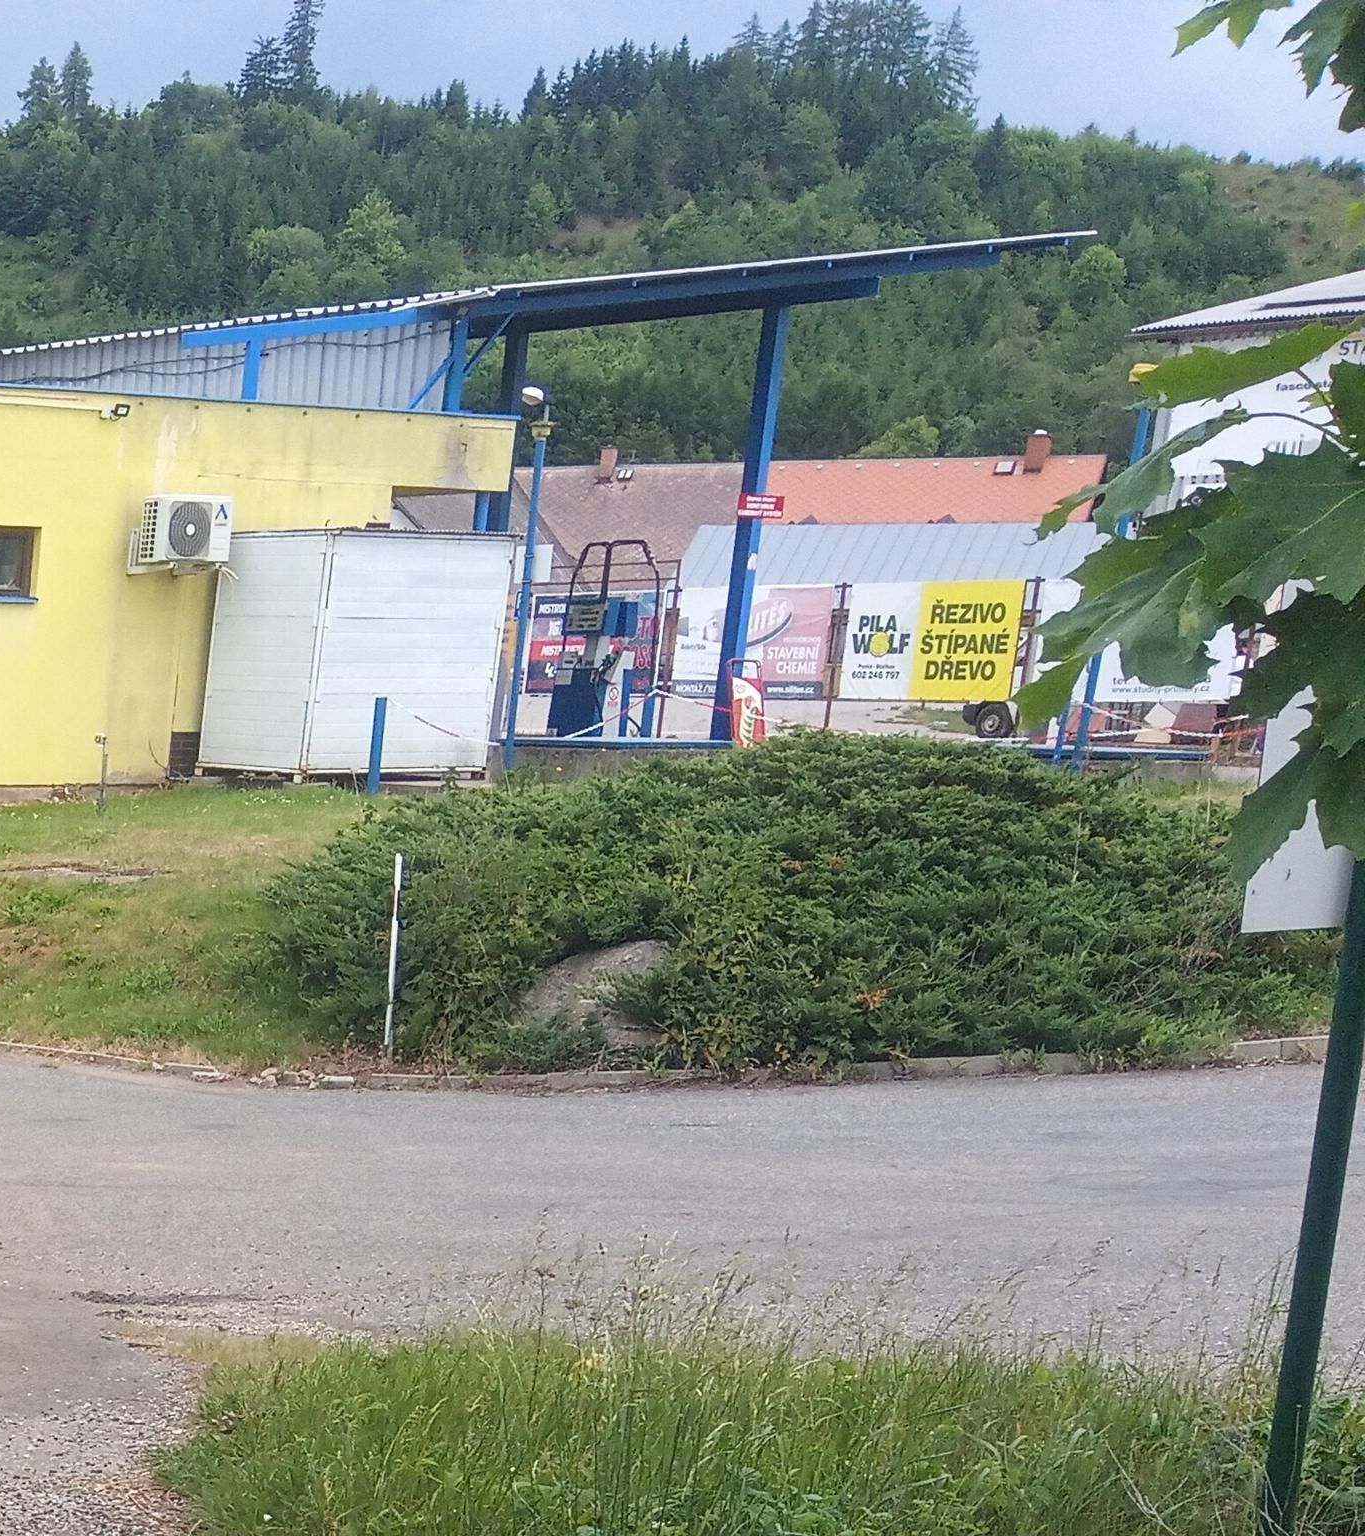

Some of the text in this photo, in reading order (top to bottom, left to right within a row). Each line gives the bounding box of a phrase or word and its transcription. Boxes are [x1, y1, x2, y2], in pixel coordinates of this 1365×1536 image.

[929, 599, 1007, 625] ŘEZIVO
[859, 614, 898, 632] PILA
[767, 643, 820, 660] STAVEBNÍ
[920, 628, 1011, 655] ŠTÍPANÉ
[776, 661, 818, 674] CHEMIE
[924, 656, 997, 681] DŘEVO
